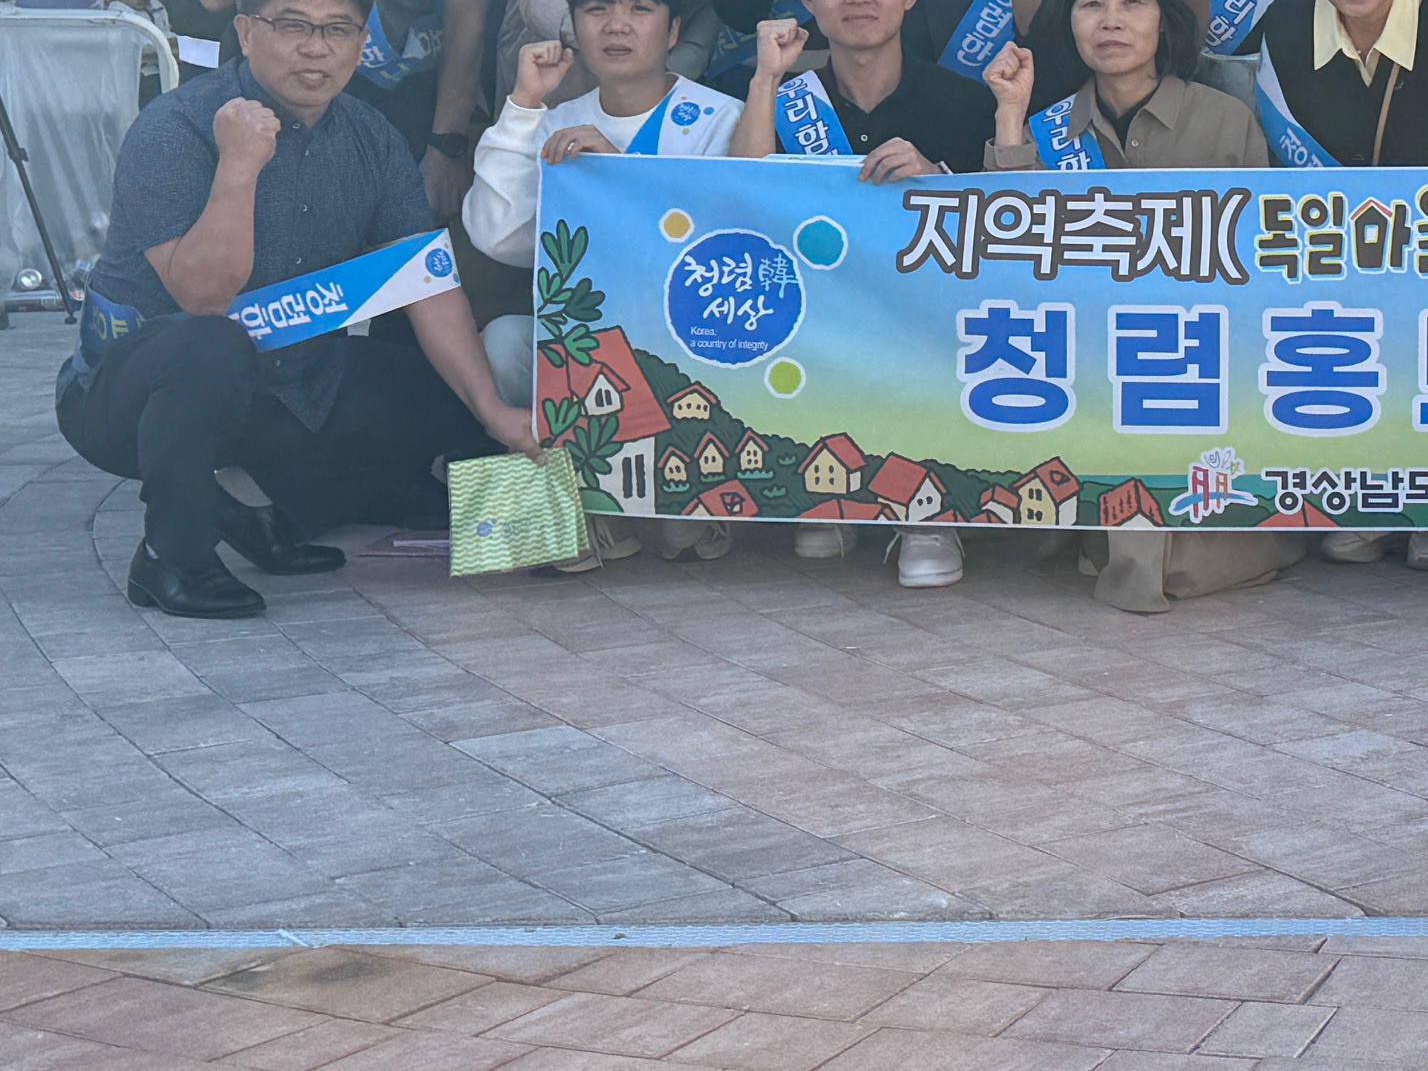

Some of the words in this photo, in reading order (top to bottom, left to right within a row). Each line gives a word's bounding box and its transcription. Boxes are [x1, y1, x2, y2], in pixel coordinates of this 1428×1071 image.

[776, 78, 839, 156] 우리함
[702, 295, 774, 331] 세상
[697, 340, 727, 349] country
[728, 338, 736, 348] of
